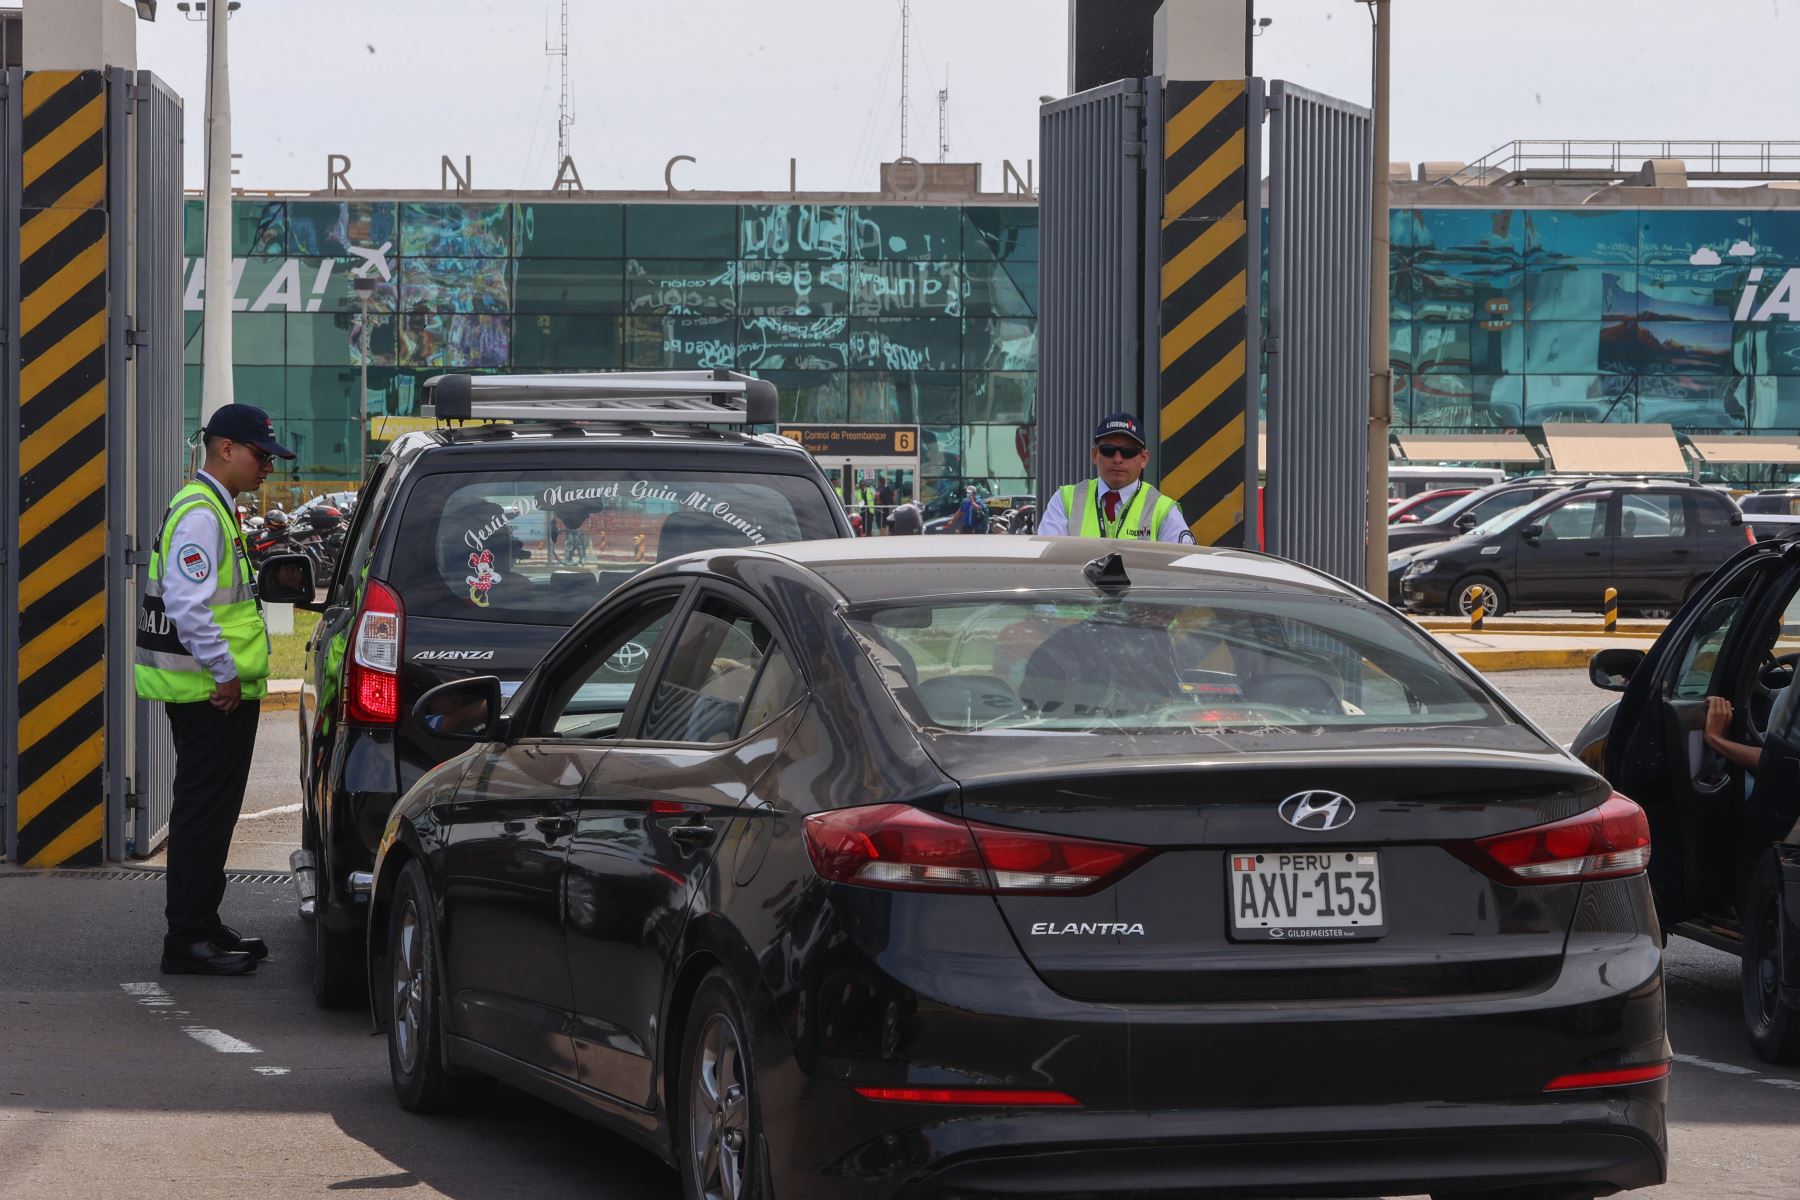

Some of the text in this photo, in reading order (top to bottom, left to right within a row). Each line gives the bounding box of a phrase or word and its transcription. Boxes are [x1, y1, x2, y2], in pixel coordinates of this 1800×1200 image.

[804, 431, 887, 442] Control de Preembarque
[900, 434, 909, 449] 6
[464, 513, 511, 551] Jesús
[512, 497, 541, 516] De
[543, 483, 620, 506] Nazaret
[680, 491, 711, 512] Mi
[712, 502, 766, 545] Camin
[412, 651, 494, 660] AVANZA
[1279, 855, 1331, 871] PERU
[1240, 871, 1377, 919] AXV-153
[1031, 922, 1145, 936] ELANTRA
[1287, 929, 1343, 938] GILDEMEISTER
